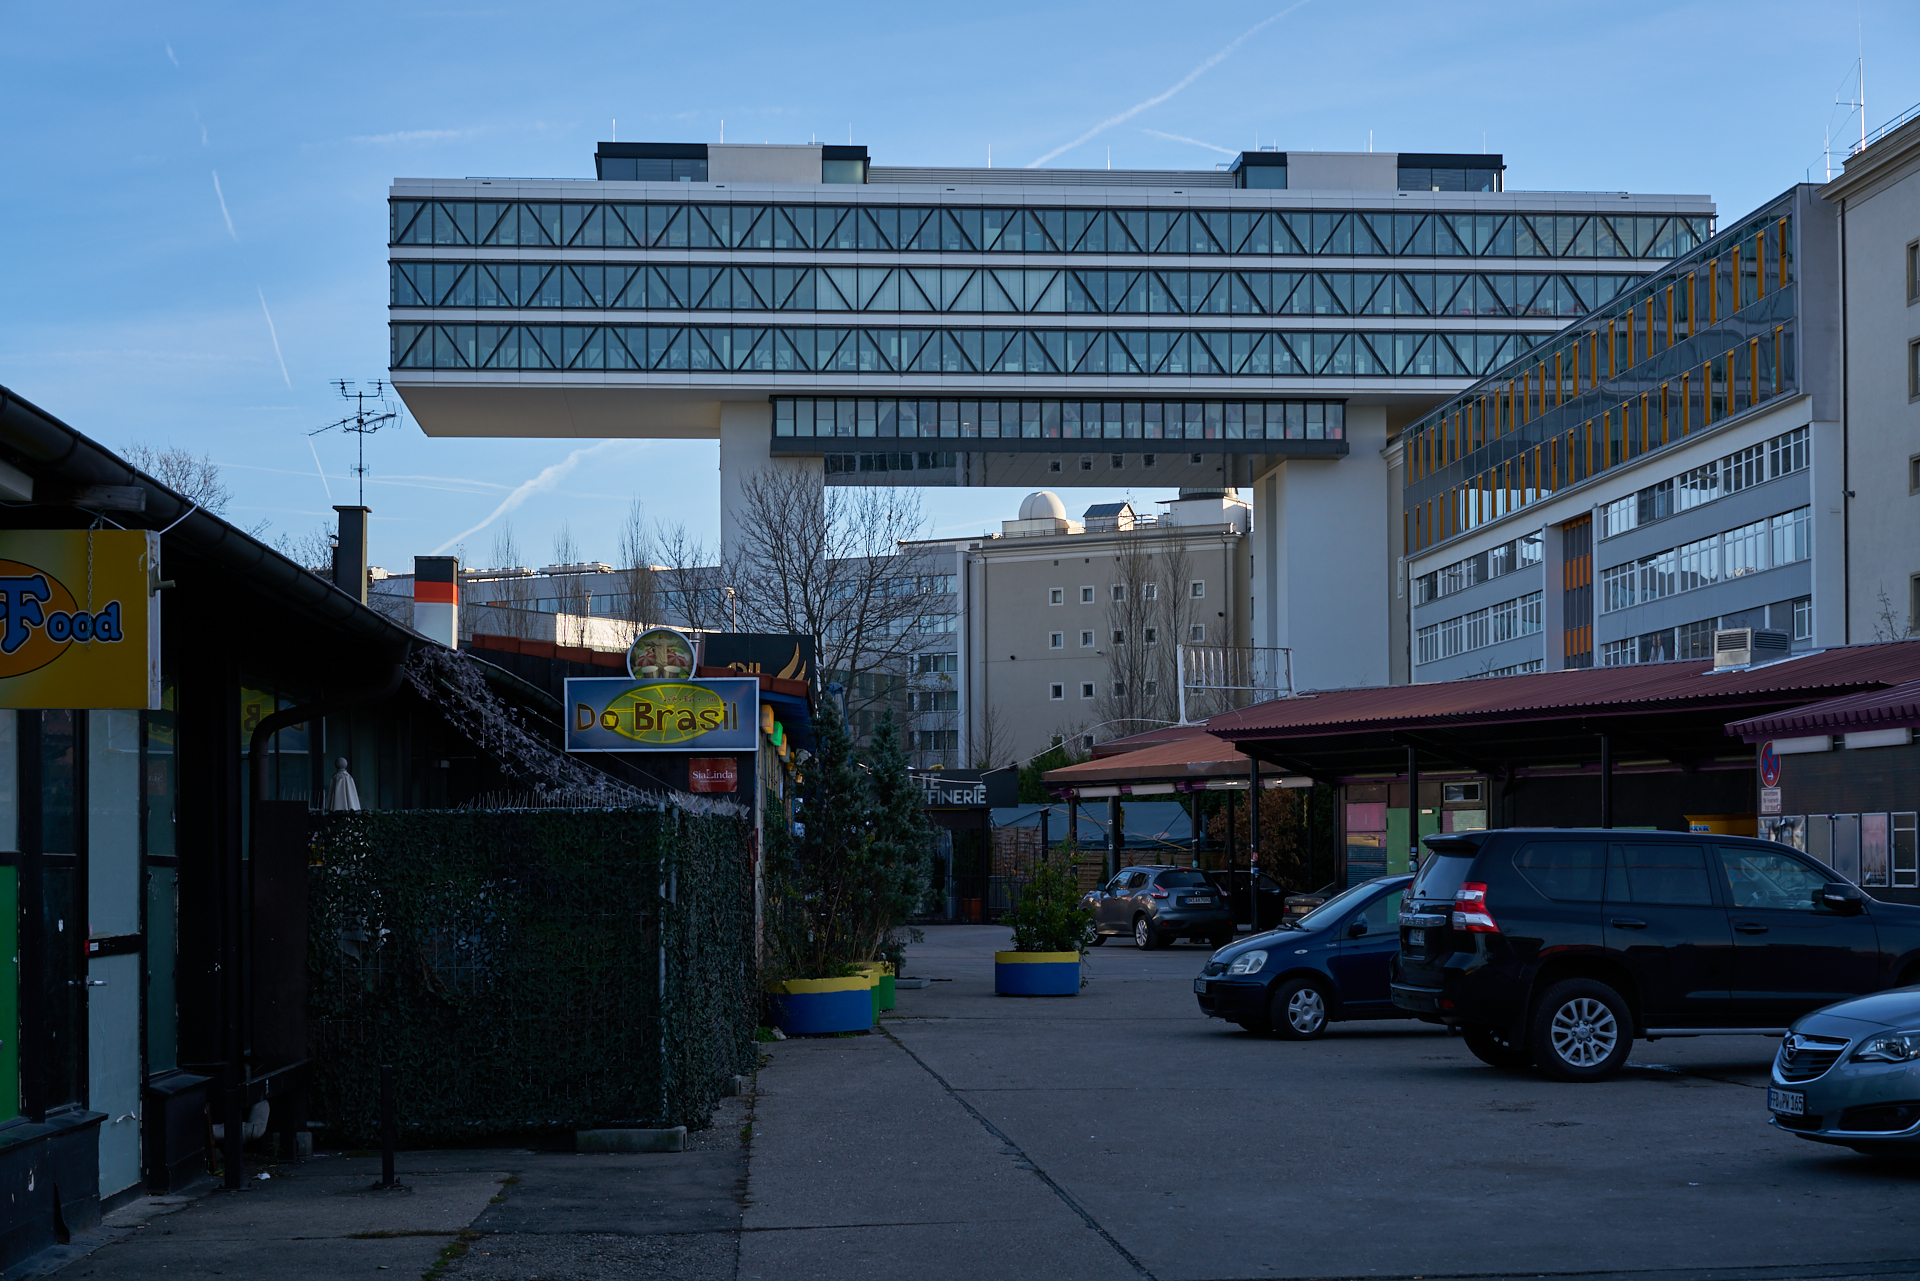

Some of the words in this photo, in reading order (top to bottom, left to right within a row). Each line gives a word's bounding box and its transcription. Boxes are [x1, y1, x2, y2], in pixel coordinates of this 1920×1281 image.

[0, 573, 124, 655] Food
[577, 703, 620, 731] Do
[633, 701, 738, 731] Brasil
[1791, 1094, 1803, 1112] 165
